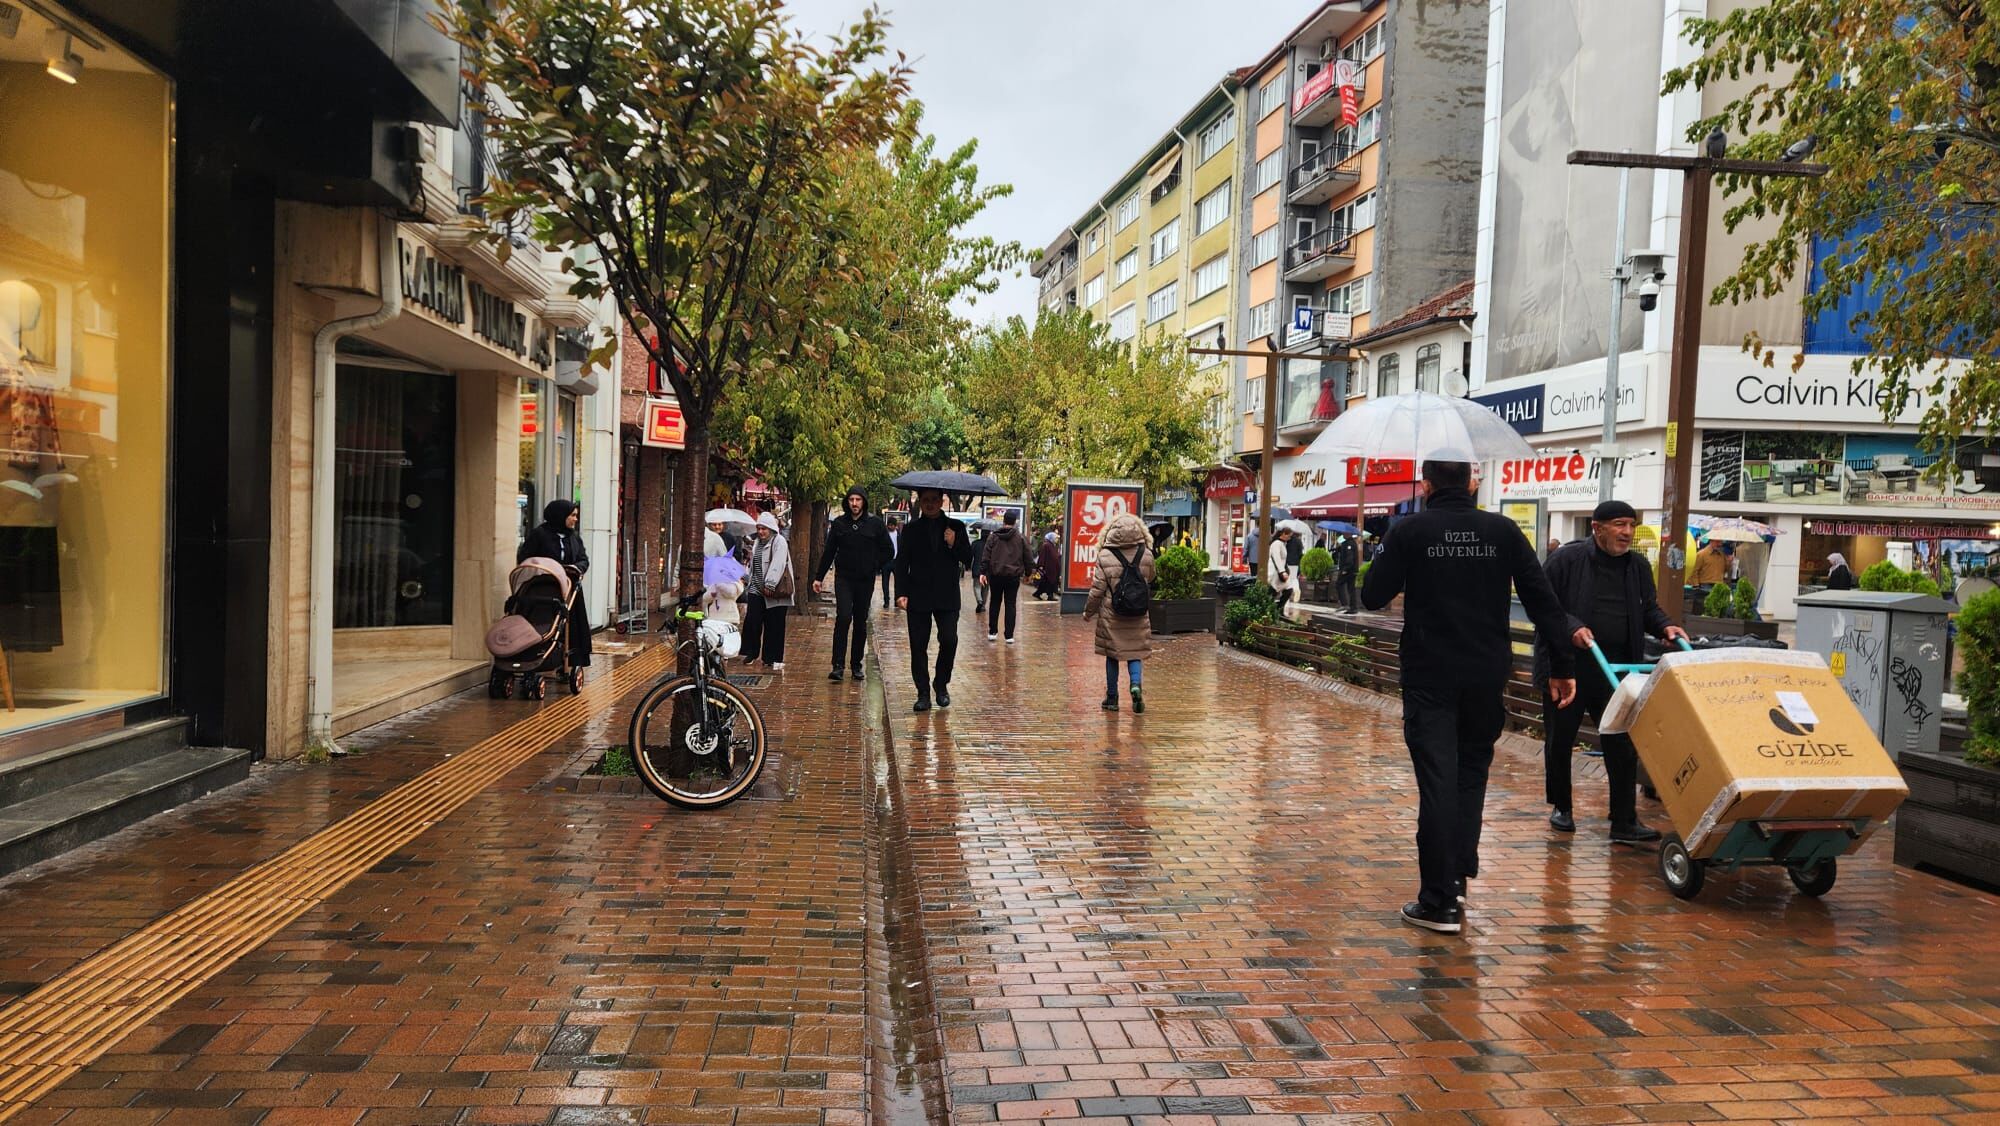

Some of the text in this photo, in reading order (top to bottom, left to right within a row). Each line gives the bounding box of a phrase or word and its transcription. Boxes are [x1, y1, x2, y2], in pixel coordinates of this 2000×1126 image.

[1550, 384, 1635, 416] Calvin Kein
[1736, 375, 1922, 408] Calvin Klen
[1505, 397, 1538, 422] HALI
[1292, 468, 1326, 490] SEÇ-AL
[1588, 457, 1626, 480] hlı
[1217, 478, 1238, 488] vodafone
[1866, 493, 1900, 502] BAHÇE
[1902, 494, 1915, 502] VE
[1916, 495, 1957, 504] BALKON
[1082, 495, 1127, 526] 50
[1445, 529, 1480, 543] ÖZEL
[1836, 521, 1897, 537] ÜRÜNLERDE
[1898, 524, 1932, 538] ELDEN
[1073, 540, 1098, 563] İND
[1427, 543, 1497, 557] GÜVENLİK
[1757, 739, 1854, 758] GÜZİDE
